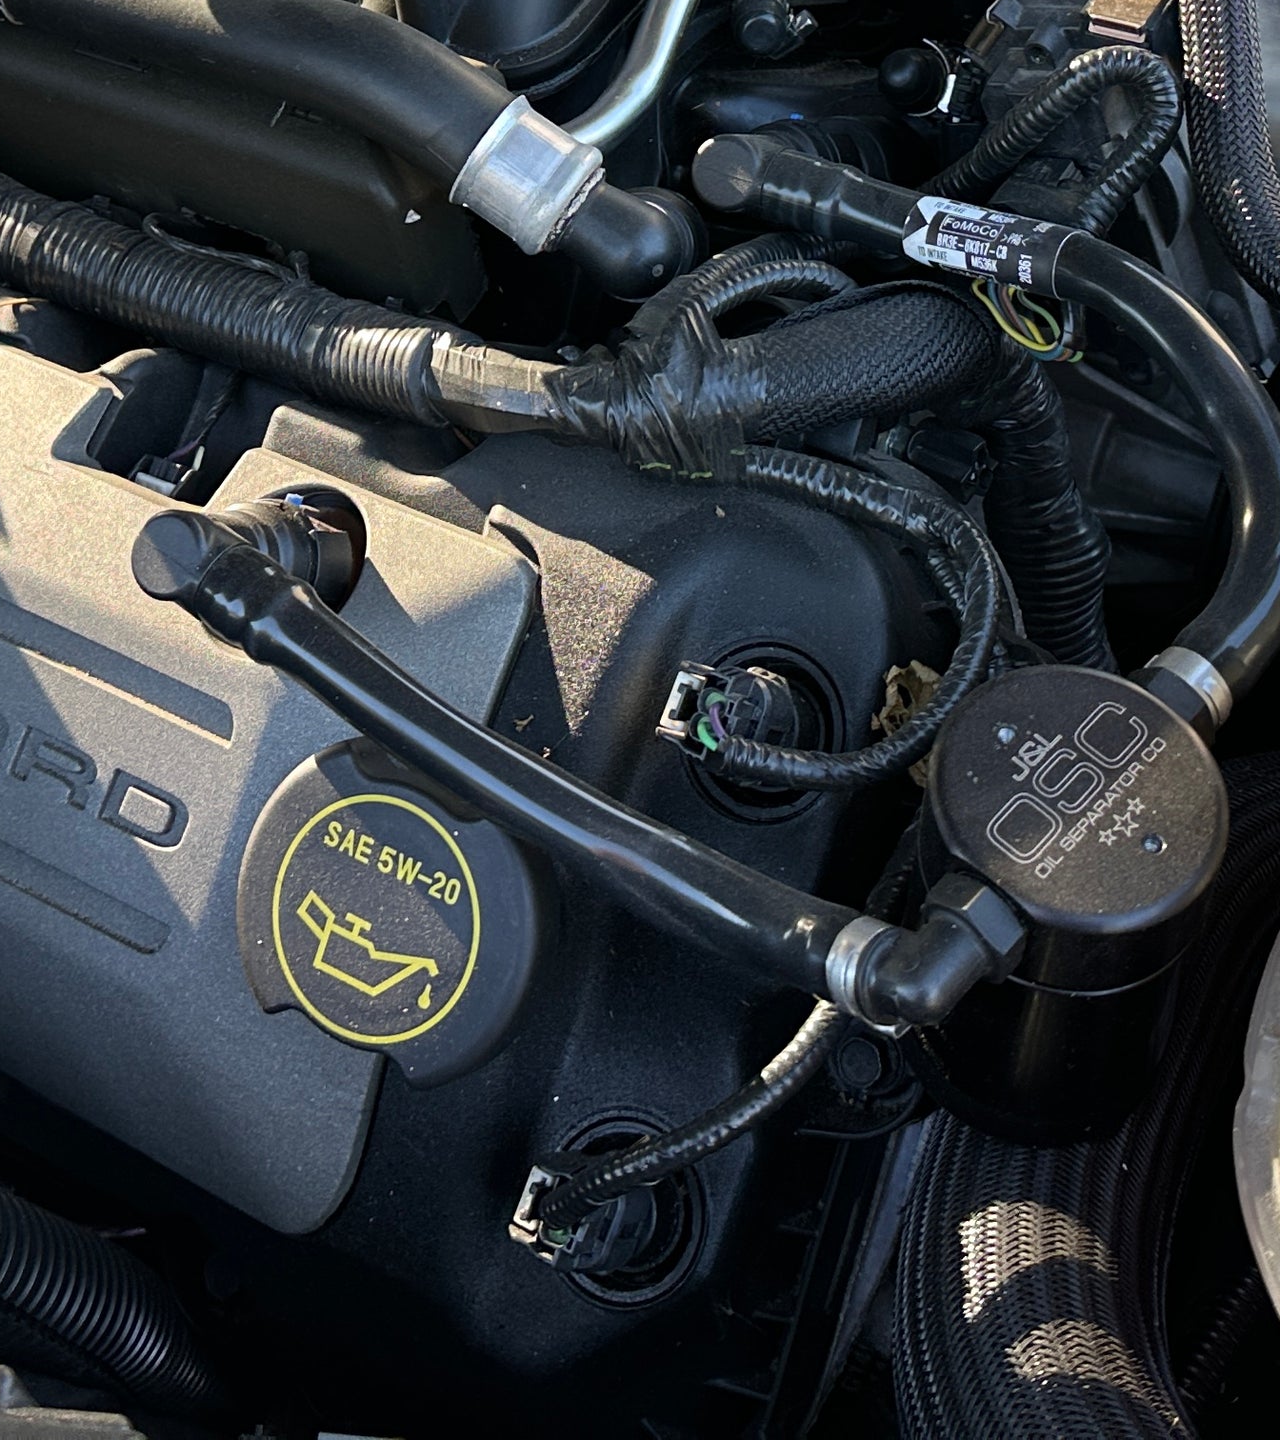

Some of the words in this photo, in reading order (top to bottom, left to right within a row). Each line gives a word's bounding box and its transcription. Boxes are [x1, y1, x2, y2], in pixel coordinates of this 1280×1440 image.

[943, 217, 998, 238] FoMoCo
[927, 248, 948, 261] INTAKE
[1018, 254, 1033, 285] 20361
[1011, 733, 1063, 782] J&L
[986, 701, 1148, 864] OSC
[1034, 855, 1064, 879] OIL
[1059, 761, 1145, 852] SEPARATOR
[1141, 736, 1167, 763] CO
[323, 821, 375, 864] SAE
[377, 845, 461, 905] 5W-20
